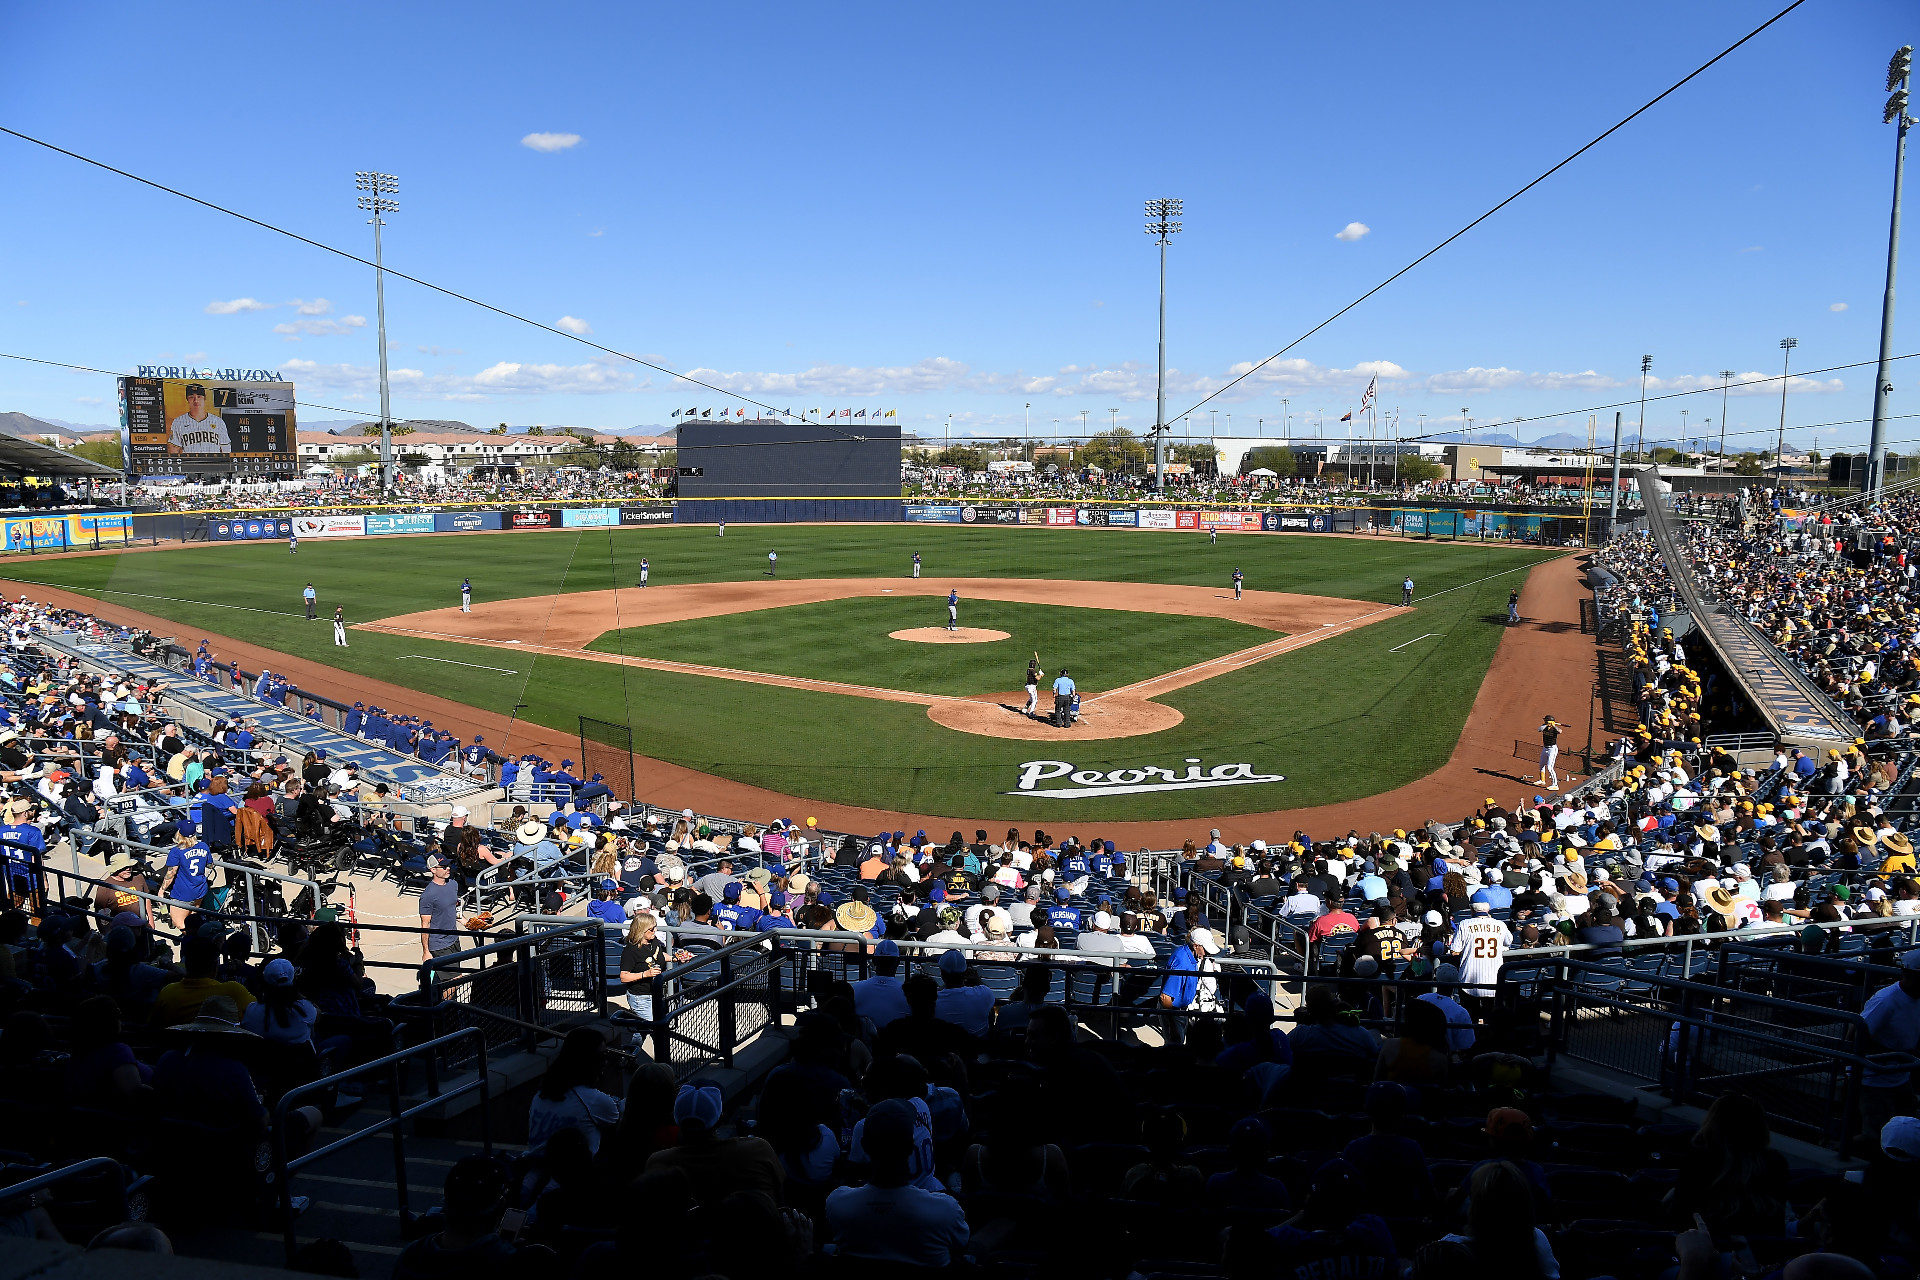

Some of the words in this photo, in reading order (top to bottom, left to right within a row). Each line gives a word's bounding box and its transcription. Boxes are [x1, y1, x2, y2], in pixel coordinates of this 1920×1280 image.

[137, 365, 200, 380] PEORIA
[214, 368, 284, 382] ARIZONA
[219, 391, 229, 406] 7
[183, 431, 219, 446] PADRES
[621, 511, 674, 521] TicketSmarter
[24, 538, 54, 547] WHEAT
[1016, 758, 1287, 790] Peoria
[121, 800, 134, 809] 103
[184, 848, 208, 860] FREEMAN
[189, 858, 200, 876] 5
[1070, 862, 1086, 871] 50
[1051, 910, 1077, 920] KERSHAW
[1746, 903, 1760, 919] 2
[1374, 930, 1394, 940] TATIS
[1468, 924, 1491, 934] TATIS
[1380, 940, 1402, 960] 23
[1474, 938, 1498, 958] 23
